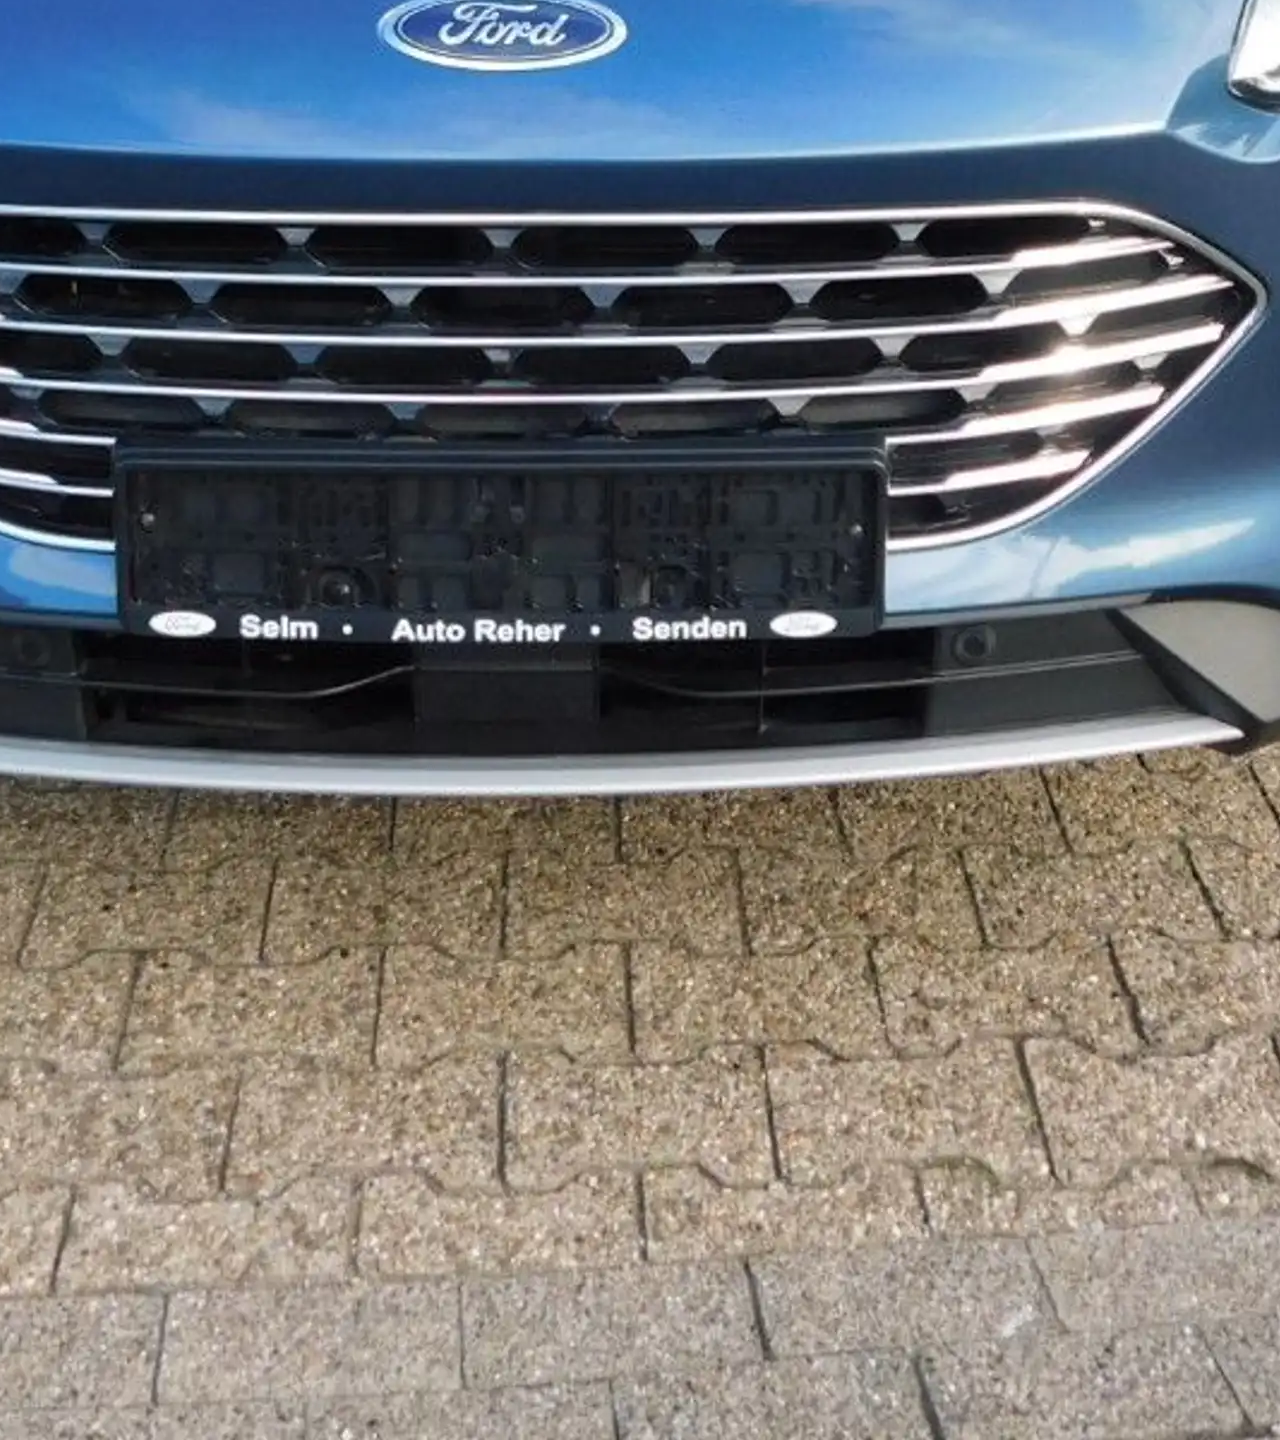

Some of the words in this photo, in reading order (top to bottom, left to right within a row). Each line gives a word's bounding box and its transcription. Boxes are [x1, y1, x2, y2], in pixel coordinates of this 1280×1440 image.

[438, 2, 569, 45] Ford
[240, 613, 319, 640] Selm
[391, 618, 467, 643] Auto
[474, 618, 566, 643] Reher
[632, 616, 748, 640] Senden
